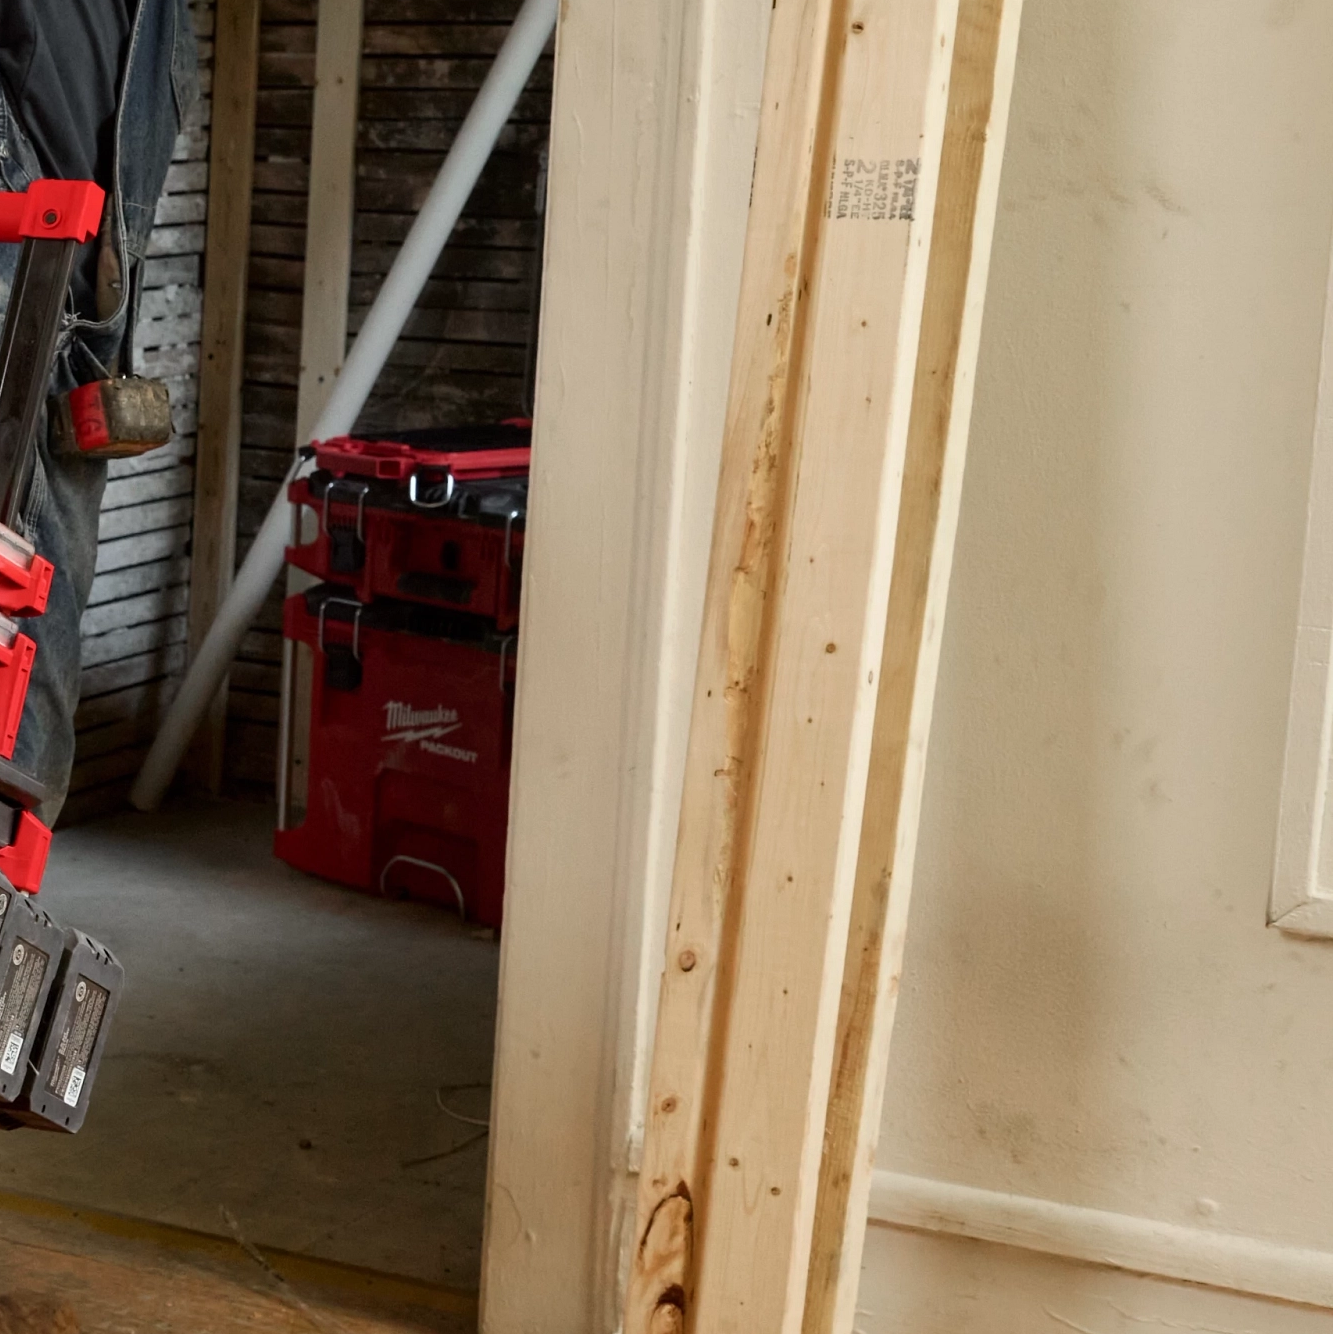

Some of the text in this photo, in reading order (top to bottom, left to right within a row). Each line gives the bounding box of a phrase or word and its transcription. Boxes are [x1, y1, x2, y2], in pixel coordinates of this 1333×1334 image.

[841, 159, 855, 189] S-P-F
[872, 193, 888, 220] 325
[383, 700, 459, 731] Milwaukee
[420, 739, 478, 764] PACKOUT
